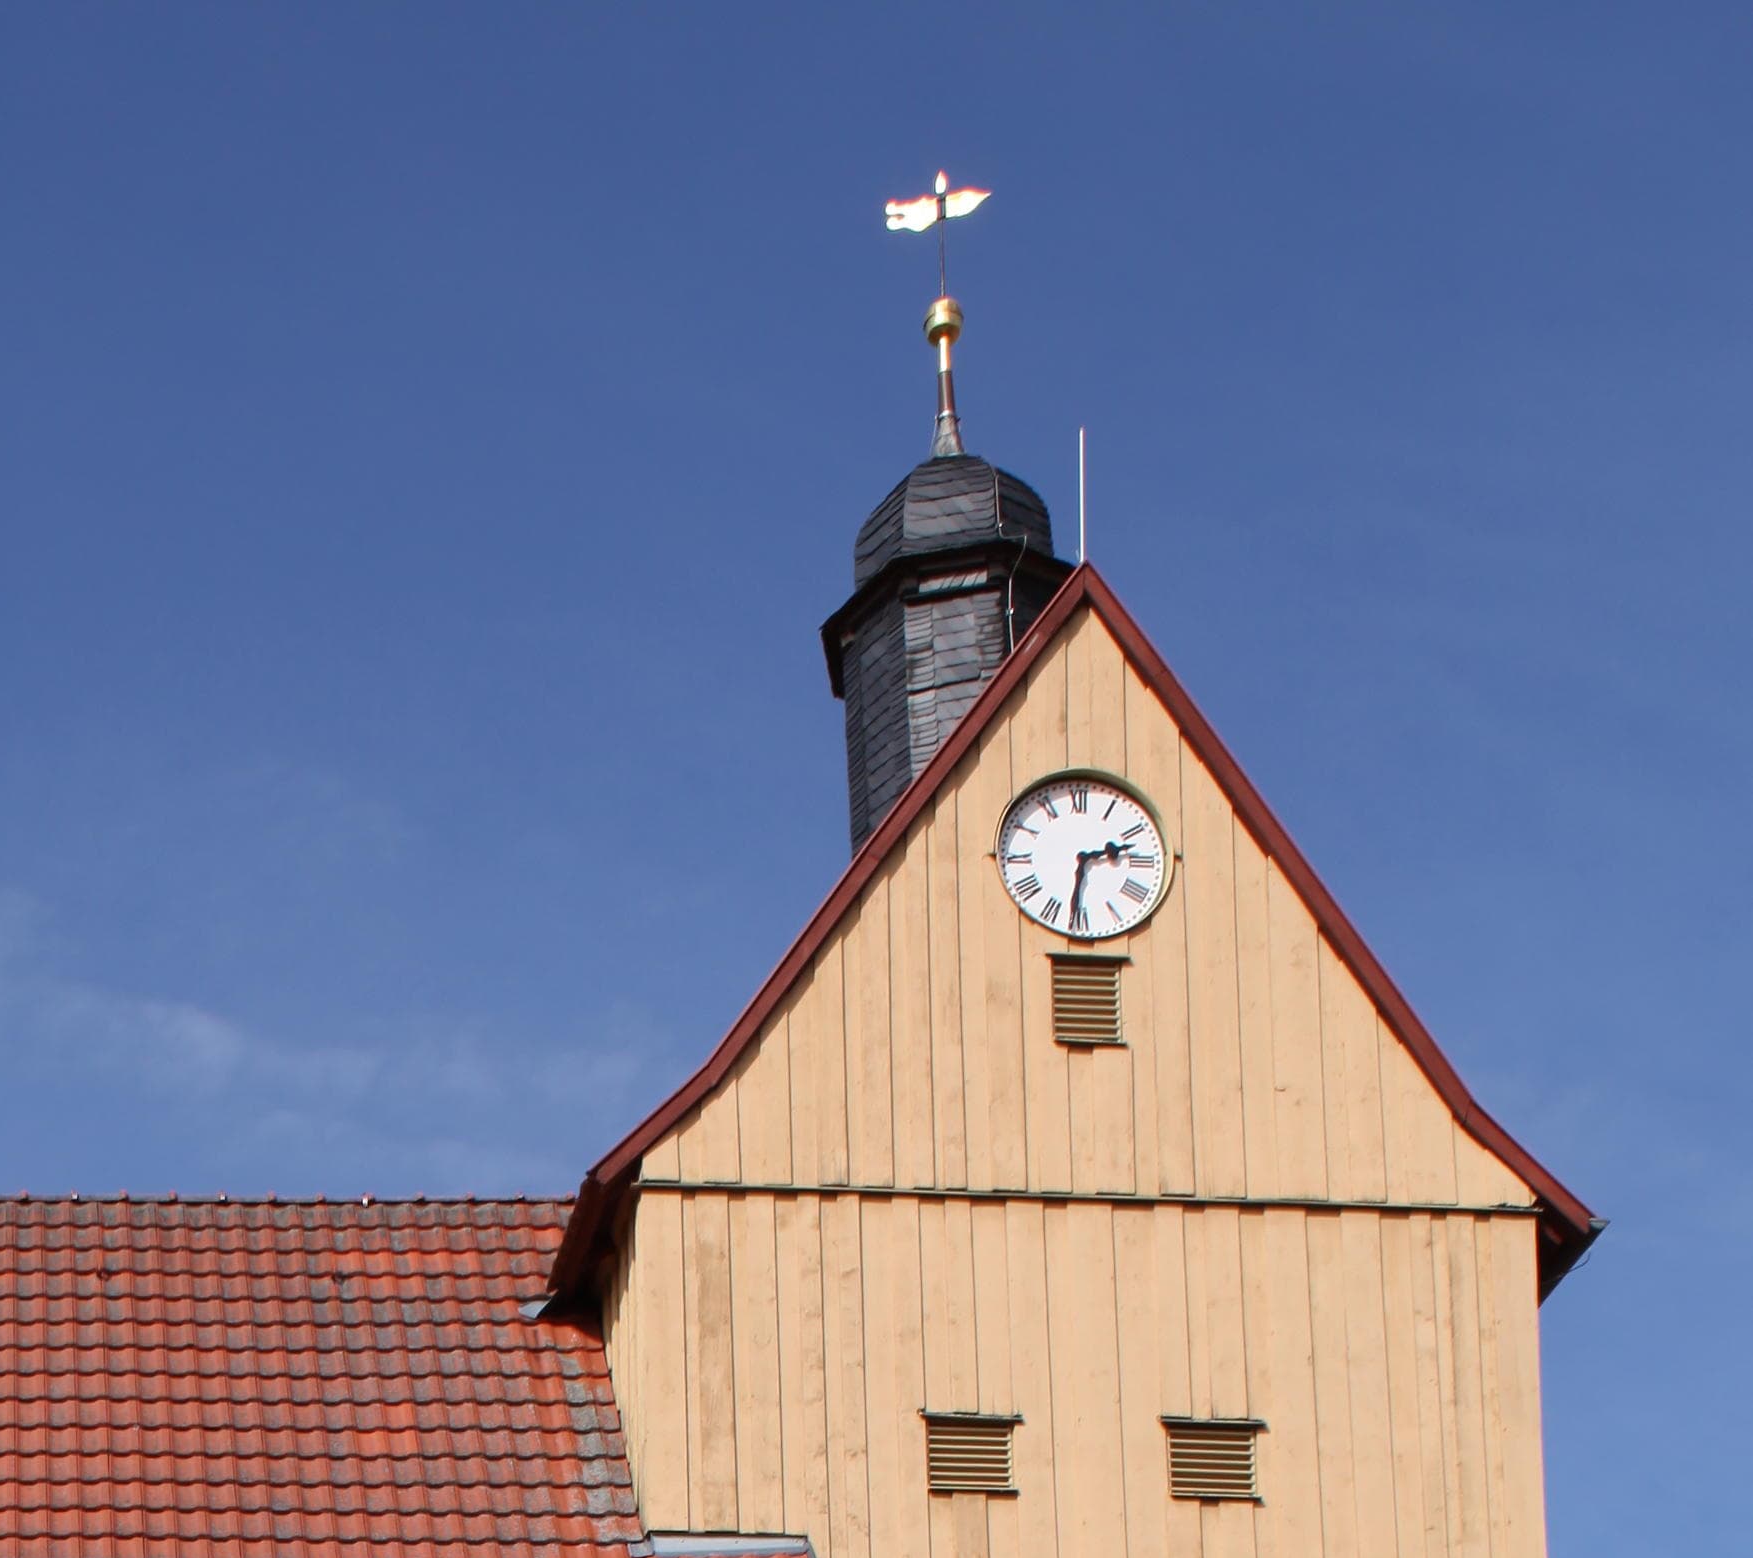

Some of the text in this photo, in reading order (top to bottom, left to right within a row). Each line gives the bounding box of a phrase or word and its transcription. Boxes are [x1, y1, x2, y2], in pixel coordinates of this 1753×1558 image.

[1070, 789, 1089, 815] XII
[1103, 798, 1117, 821] I
[1120, 822, 1145, 841] II
[1128, 855, 1155, 869] III
[1013, 873, 1043, 903] VIII
[1120, 878, 1150, 904] IIII
[1039, 896, 1063, 925] VII
